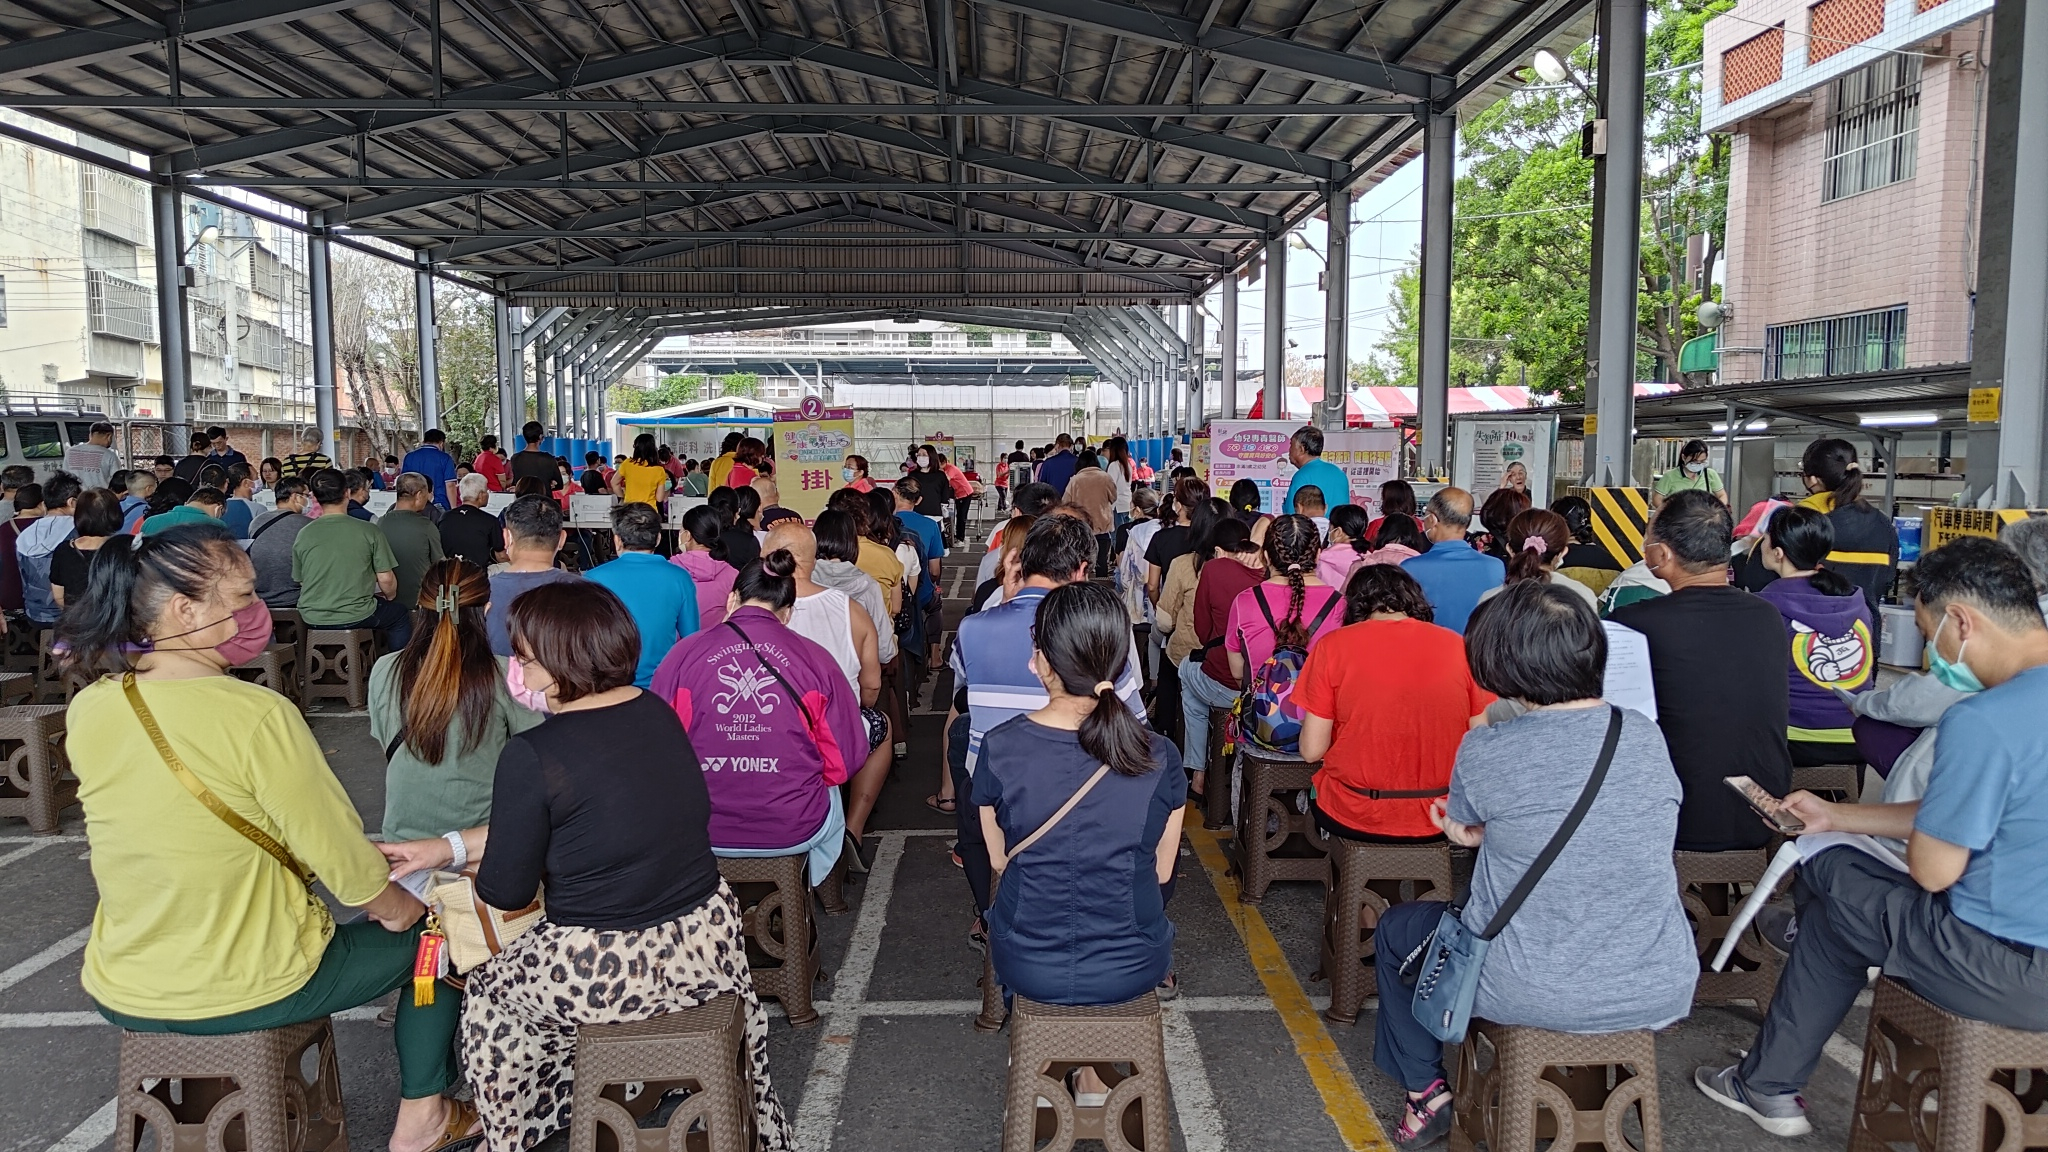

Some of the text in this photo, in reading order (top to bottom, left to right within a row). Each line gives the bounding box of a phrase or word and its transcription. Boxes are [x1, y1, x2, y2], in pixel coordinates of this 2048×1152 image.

[807, 400, 818, 416] 2
[1934, 507, 1994, 533] 汽車停車時間
[762, 642, 791, 667] Skirts
[732, 713, 756, 723] 2012
[715, 723, 772, 733] World Ladies
[726, 732, 760, 741] Masters
[730, 756, 779, 773] YONEX
